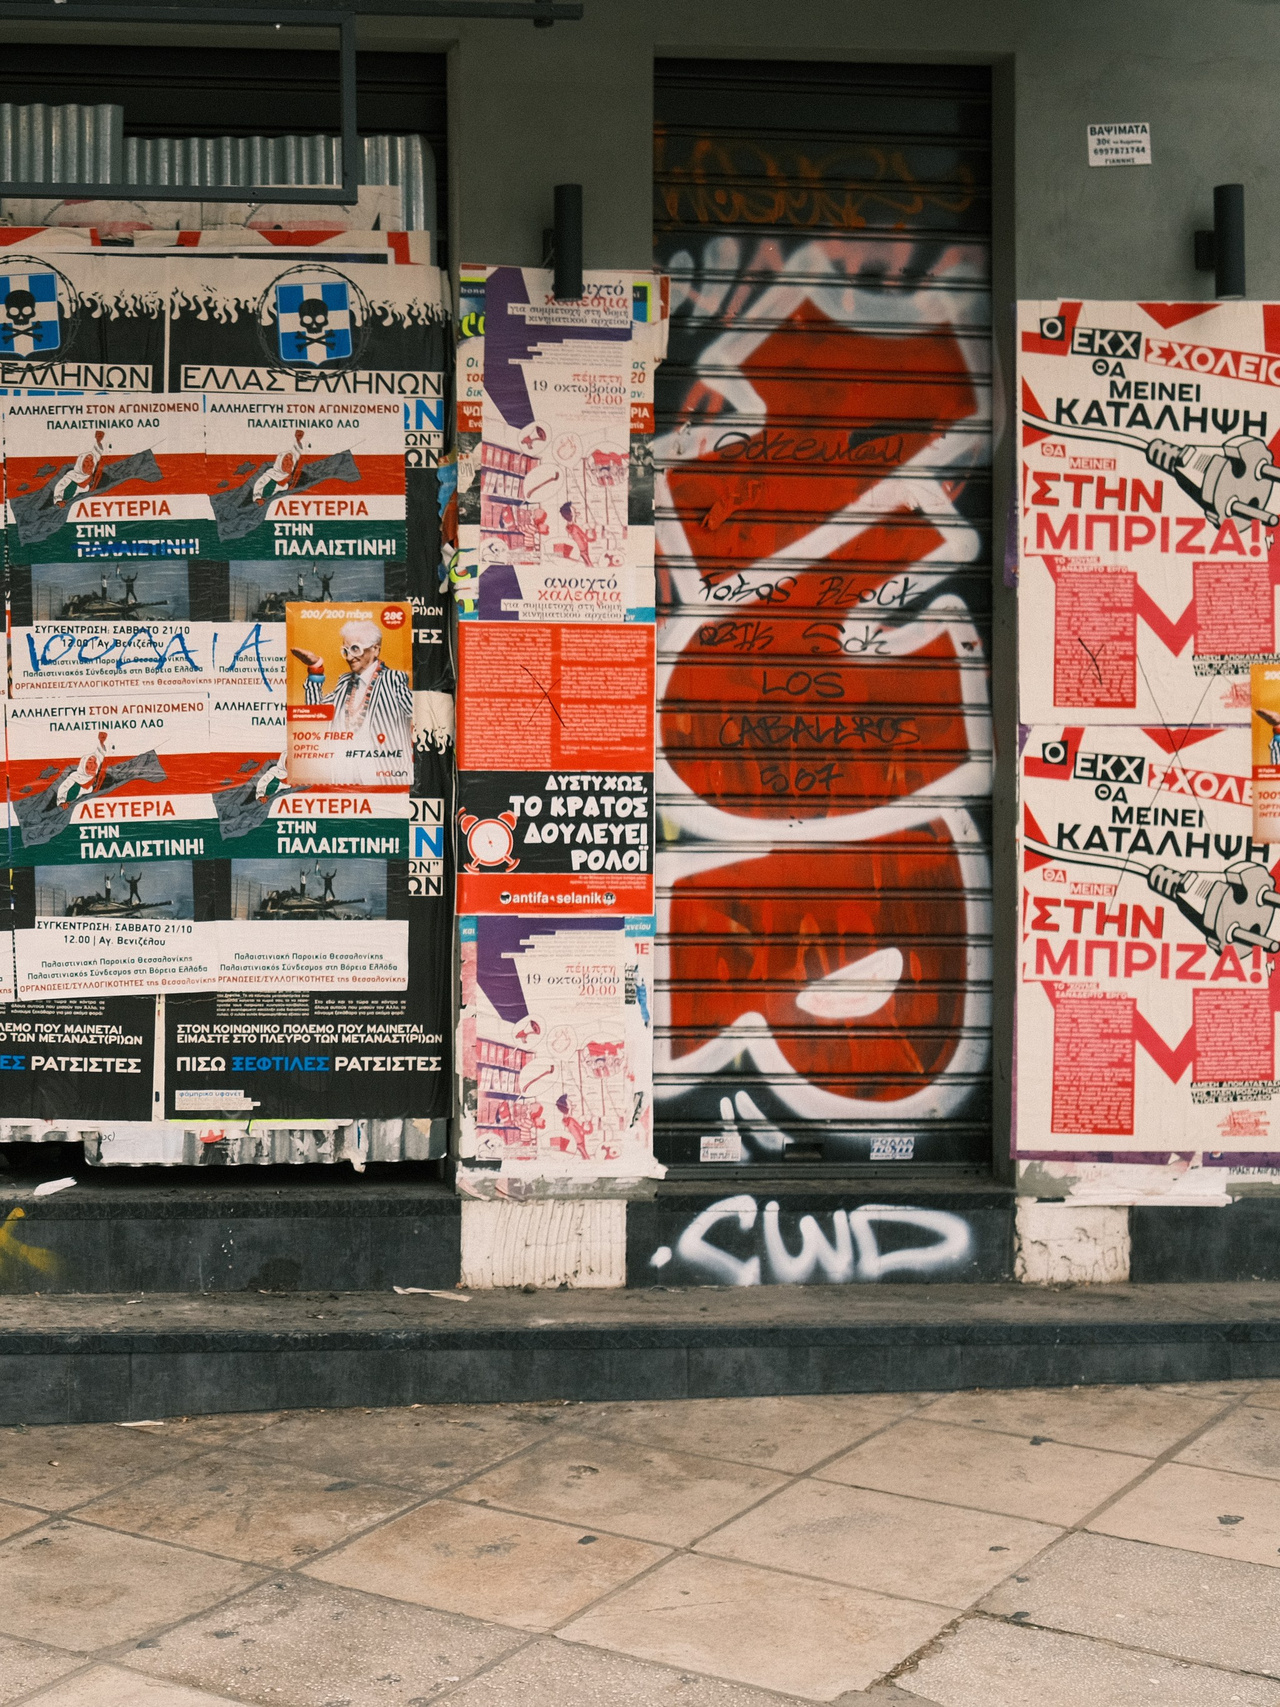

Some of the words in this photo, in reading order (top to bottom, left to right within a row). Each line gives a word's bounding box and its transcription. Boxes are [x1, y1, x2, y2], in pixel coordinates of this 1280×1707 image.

[1090, 125, 1148, 136] ΒΑΨΙΜΑΤΑ
[1042, 318, 1062, 339] Ο
[1073, 329, 1139, 358] ΕΚΧ
[1, 364, 150, 390] ΕΛΛΗΝΩΝ
[1092, 358, 1126, 379] ΘΑ
[183, 366, 279, 393] ΕΛΛΑΣ
[295, 369, 442, 396] ΕΛΛΗΝΩΝ
[1110, 381, 1201, 402] ΜΕΙΝΕΙ
[1056, 398, 1267, 437] ΚΑΤΑΛΗΨΗ
[1043, 444, 1064, 457] ΘΑ
[1070, 457, 1116, 470] ΜΕΙΝΕΙ
[1031, 471, 1163, 513] ΣΤΗΝ
[275, 501, 369, 517] ΛΕΥΤΕΡΙΑ
[274, 523, 314, 537] ΣΤΗΝ
[1036, 512, 1262, 557] ΜΠΡΙΖΑ!
[275, 539, 396, 556] ΠΑΛΑΙΣΤΙΝΗ!
[301, 609, 345, 619] 200/200
[347, 610, 373, 620] mbps
[384, 612, 403, 621] 28€
[761, 670, 845, 699] LOS
[292, 732, 321, 740] 100%
[324, 732, 353, 740] FIBER
[346, 750, 402, 758] #FTASAME
[1045, 742, 1065, 764] Ο
[1075, 754, 1143, 784] ΕΚΧ
[545, 776, 648, 794] ΔΥΣΤΥΧΩΣ,
[1095, 783, 1128, 803] ΘΑ
[79, 800, 175, 819] ΛΕΥΤΕΡΙΑ
[509, 796, 543, 817] ΤΟ
[550, 796, 648, 818] ΚΡΑΤΟΣ
[1112, 806, 1204, 828] ΜΕΙΝΕΙ
[79, 825, 120, 840] ΣΤΗΝ
[524, 822, 648, 845] ΔΟΥΛΕΥΕΙ
[80, 839, 204, 859] ΠΑΛΑΙΣΤΙΝΗ!
[1057, 822, 1270, 863] ΚΑΤΑΛΗΨΗ
[512, 891, 550, 904] antifa
[556, 892, 602, 905] selanik
[1031, 896, 1164, 939] ΣΤΗΝ
[36, 920, 112, 932] ΣΥΓΚΕΝΤΡΩΣΗ:
[115, 923, 161, 934] ΣΑΒΒΑΤΟ
[164, 924, 193, 935] 21/10
[64, 935, 89, 945] 12.00
[99, 935, 114, 947] Αγ.
[117, 936, 166, 948] Βενιζέλου
[1035, 938, 1263, 984] ΜΠΡΙΖΑ!
[177, 1024, 211, 1034] ΣΤΟΝ
[214, 1024, 280, 1034] ΚΟΙΝΩΝΙΚΟ
[284, 1024, 334, 1034] ΠΟΛΕΜΟ
[337, 1024, 363, 1034] ΠΟΥ
[367, 1024, 423, 1034] ΜΑΙΝΕΤΑΙ
[177, 1034, 229, 1044] ΕΙΜΑΣΤΕ
[232, 1034, 257, 1044] ΣΤΟ
[259, 1034, 312, 1044] ΠΛΕΥΡΟ
[314, 1034, 337, 1044] ΤΩΝ
[340, 1034, 442, 1045] ΜΕΤΑΝΑΣΤ(ΡΙ)ΩΝ
[176, 1056, 226, 1072] ΠΙΣΩ
[231, 1055, 330, 1071] ΞΕΦΤΙΛΕΣ
[335, 1056, 442, 1072] ΡΑΤΣΙΣΤΕΣ
